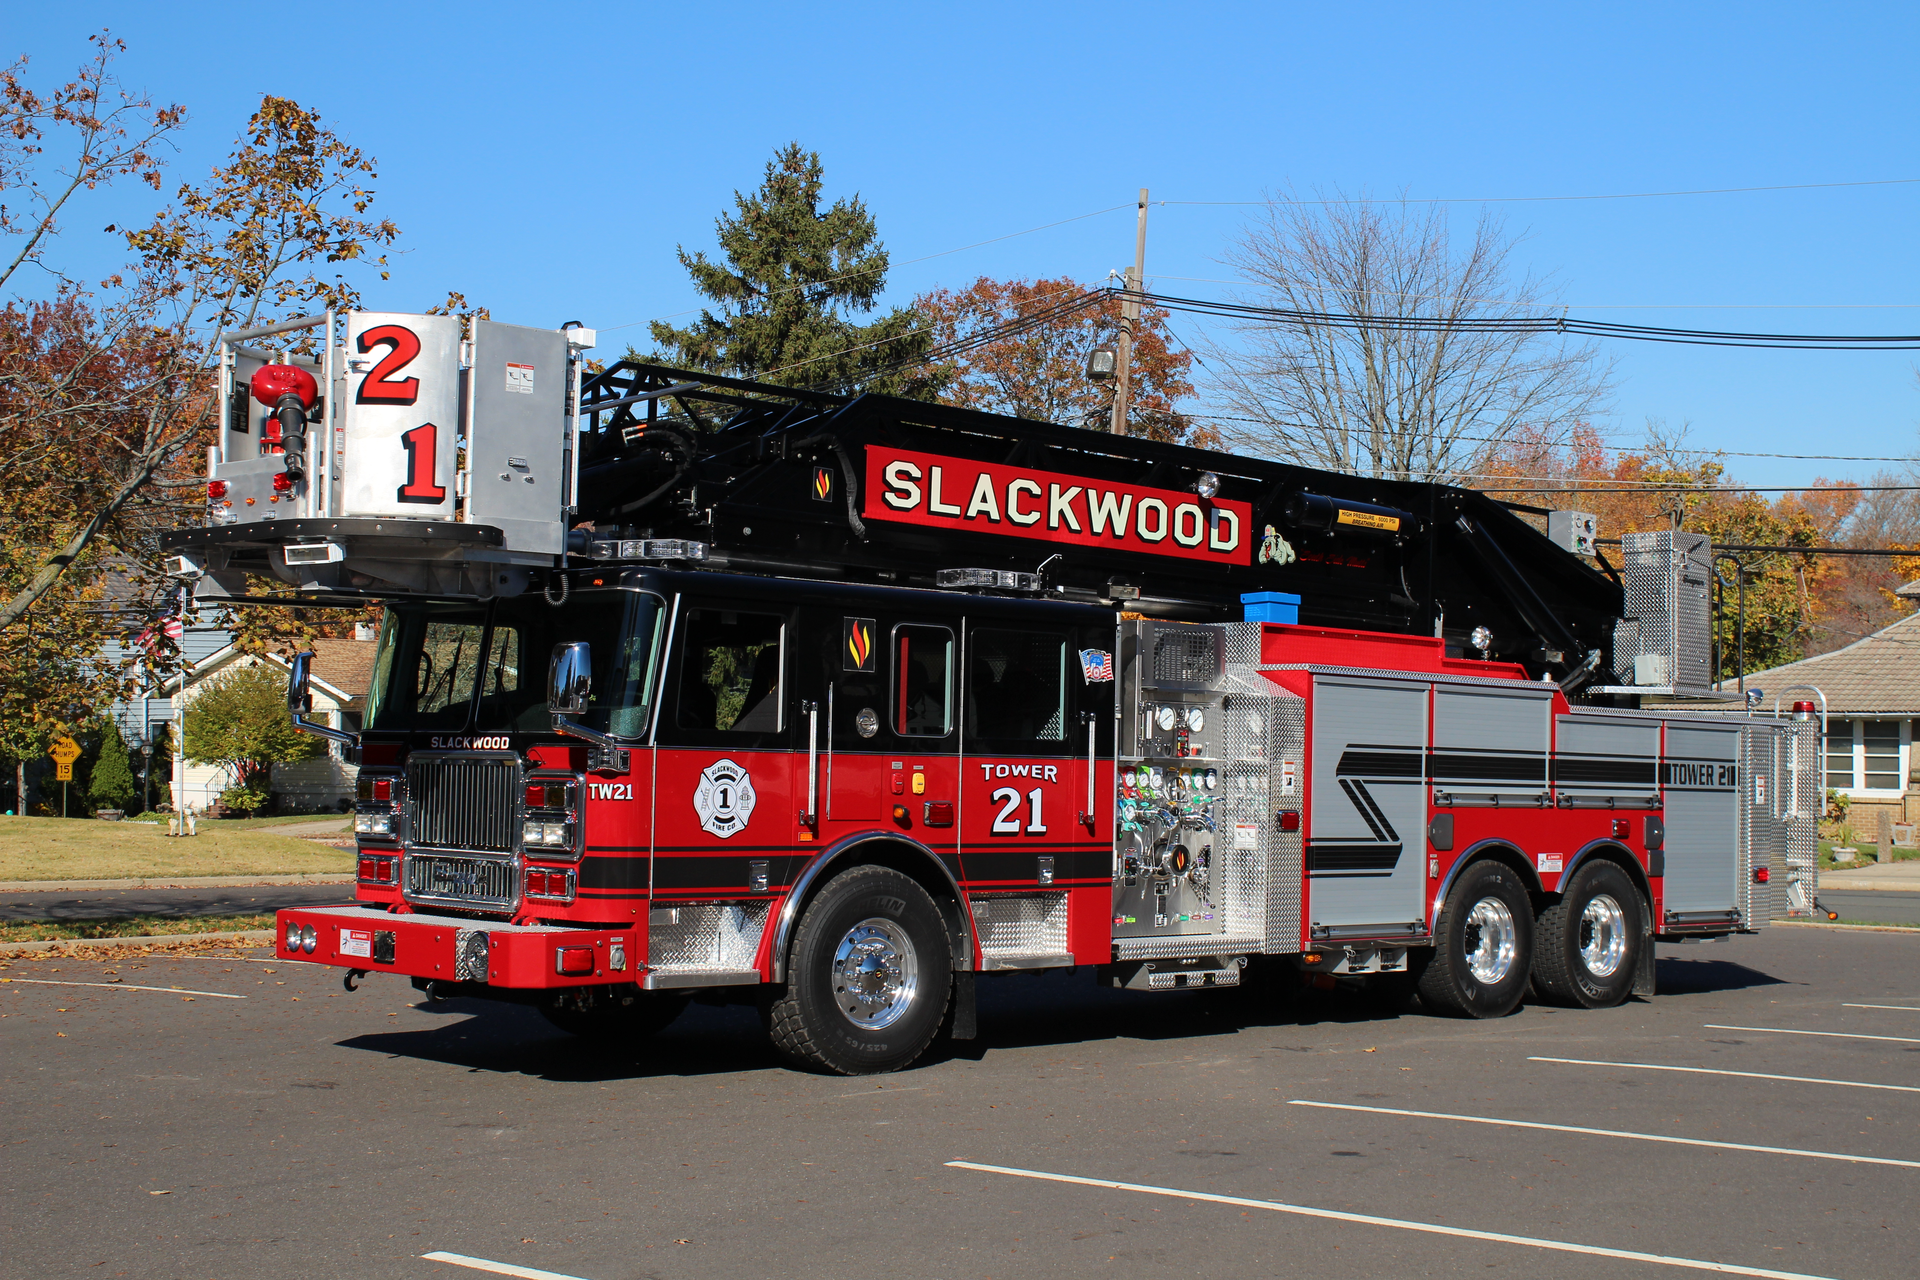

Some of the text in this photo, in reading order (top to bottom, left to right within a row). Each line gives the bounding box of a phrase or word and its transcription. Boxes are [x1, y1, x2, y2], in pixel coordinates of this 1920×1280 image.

[356, 324, 421, 406] 2
[397, 422, 446, 504] 1
[883, 460, 1240, 553] SLACKWOOD
[1351, 519, 1376, 528] BREATHING
[1353, 512, 1375, 521] PRESSURE
[431, 736, 509, 750] SLACKWOOD
[55, 750, 75, 758] HUMPS
[59, 765, 70, 774] 15
[711, 765, 739, 777] SLACKWOOD
[981, 763, 1058, 784] TOWER
[1671, 763, 1731, 786] TOWER 21
[588, 783, 634, 801] TW21
[719, 787, 731, 809] 1
[990, 786, 1047, 837] 21
[712, 821, 725, 831] FIRE
